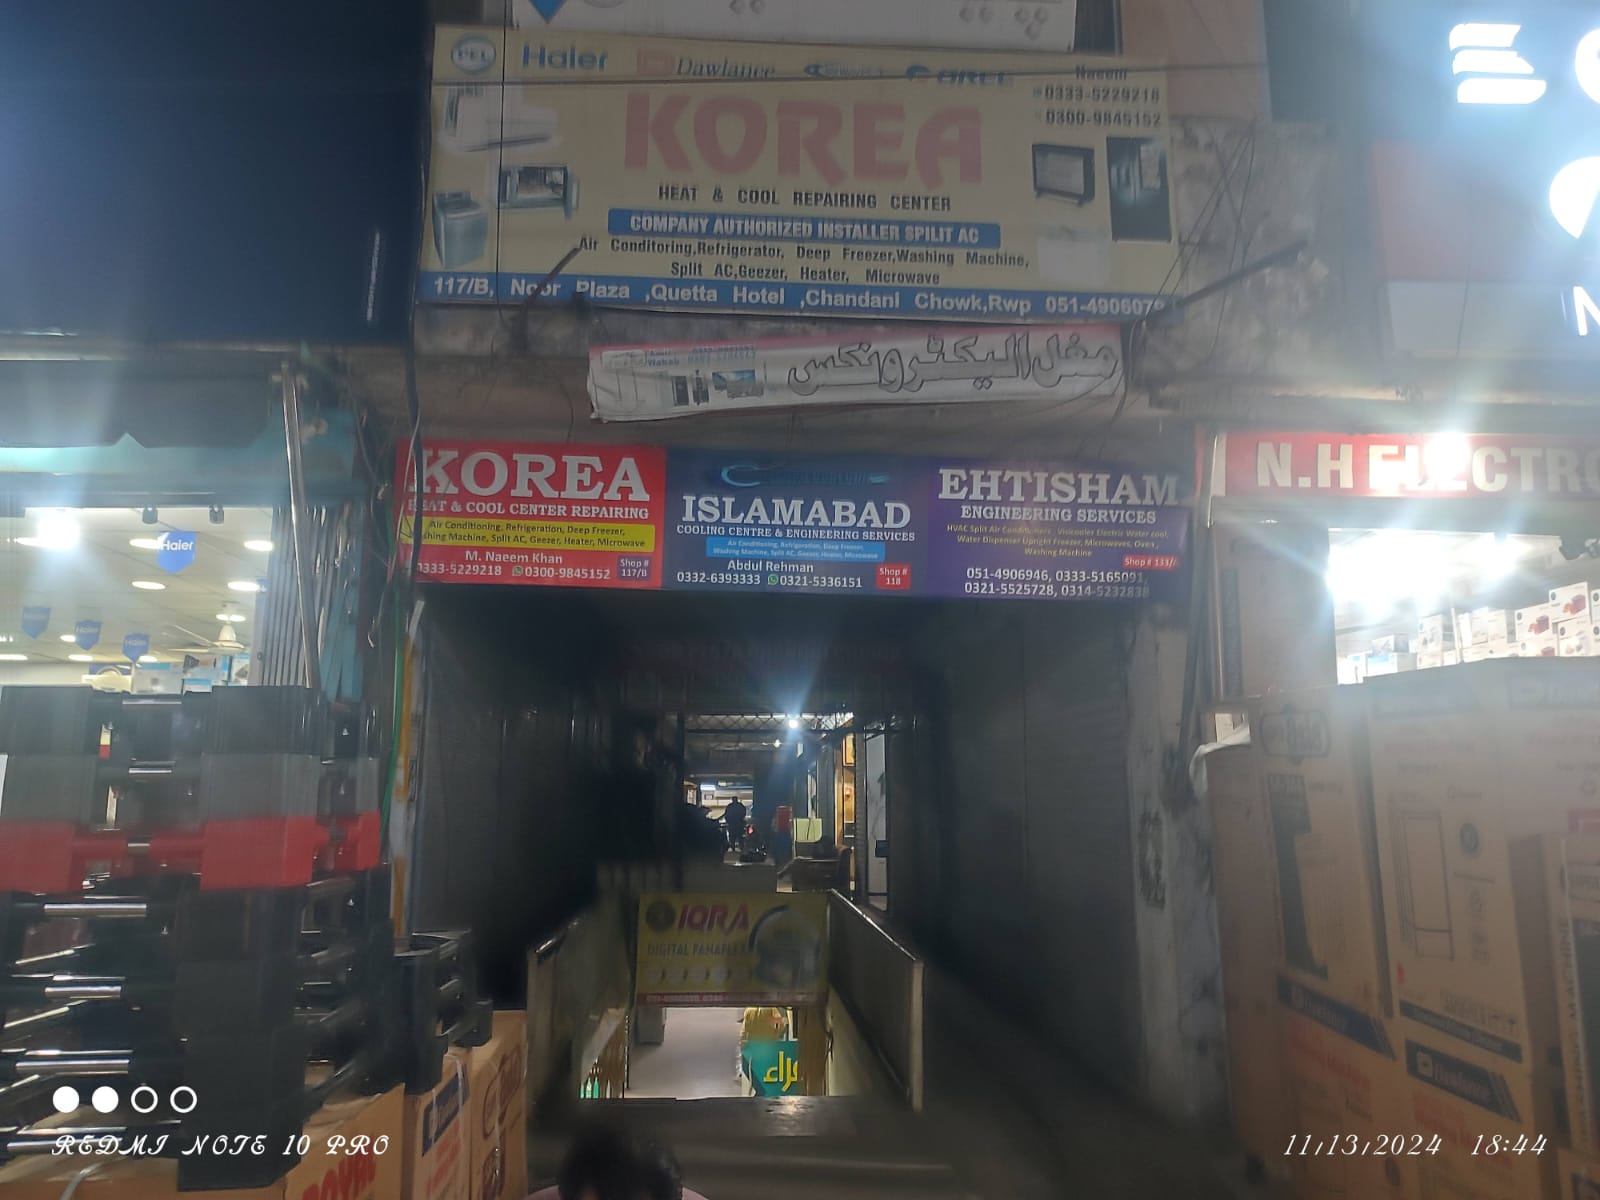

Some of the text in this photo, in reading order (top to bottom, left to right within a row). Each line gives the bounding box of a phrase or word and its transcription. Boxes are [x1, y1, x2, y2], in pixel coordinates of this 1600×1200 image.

[624, 92, 982, 189] KOREA
[659, 186, 951, 212] HEAT & COOL REPAIRING CENTER
[630, 215, 980, 244] COMPANY AUTHORIZED INSTALLER SPILIT AC
[579, 236, 598, 251] Air
[797, 246, 831, 262] Deep
[966, 251, 1030, 269] Machine,
[671, 261, 703, 280] Split
[800, 267, 850, 284] Heater,
[865, 269, 940, 286] Microwave
[435, 276, 495, 298] 117/B,
[576, 280, 630, 298] Plaza
[733, 286, 785, 306] Hotel
[407, 449, 651, 502] KOREA
[1257, 442, 1600, 493] N.H ELCTR
[938, 468, 1180, 506] EHTISHAM
[451, 502, 462, 513] &
[466, 502, 505, 514] COOL
[509, 503, 567, 517] CENTER
[571, 505, 650, 520] REPAIRING
[682, 494, 912, 529] ISLAMABAD
[961, 504, 1157, 524] ENGINEERING SERVICES
[505, 523, 564, 535] Refrigeration,
[567, 525, 590, 537] Deep
[676, 524, 916, 543] COOLING CENTRE & ENGINEERING SERVICES
[491, 534, 511, 546] Split
[564, 537, 595, 548] Heater,
[597, 538, 646, 549] Microwave
[465, 550, 563, 565] M. Naeem Khan
[620, 558, 642, 570] Shop
[727, 559, 814, 573] Abdul Rehman
[1124, 556, 1145, 568] Shop
[525, 565, 610, 580] 0300-9845152
[621, 568, 647, 578] 117/B
[780, 574, 862, 588] 0321-5336151
[879, 567, 900, 578] Shop
[648, 943, 689, 956] DIGITAL
